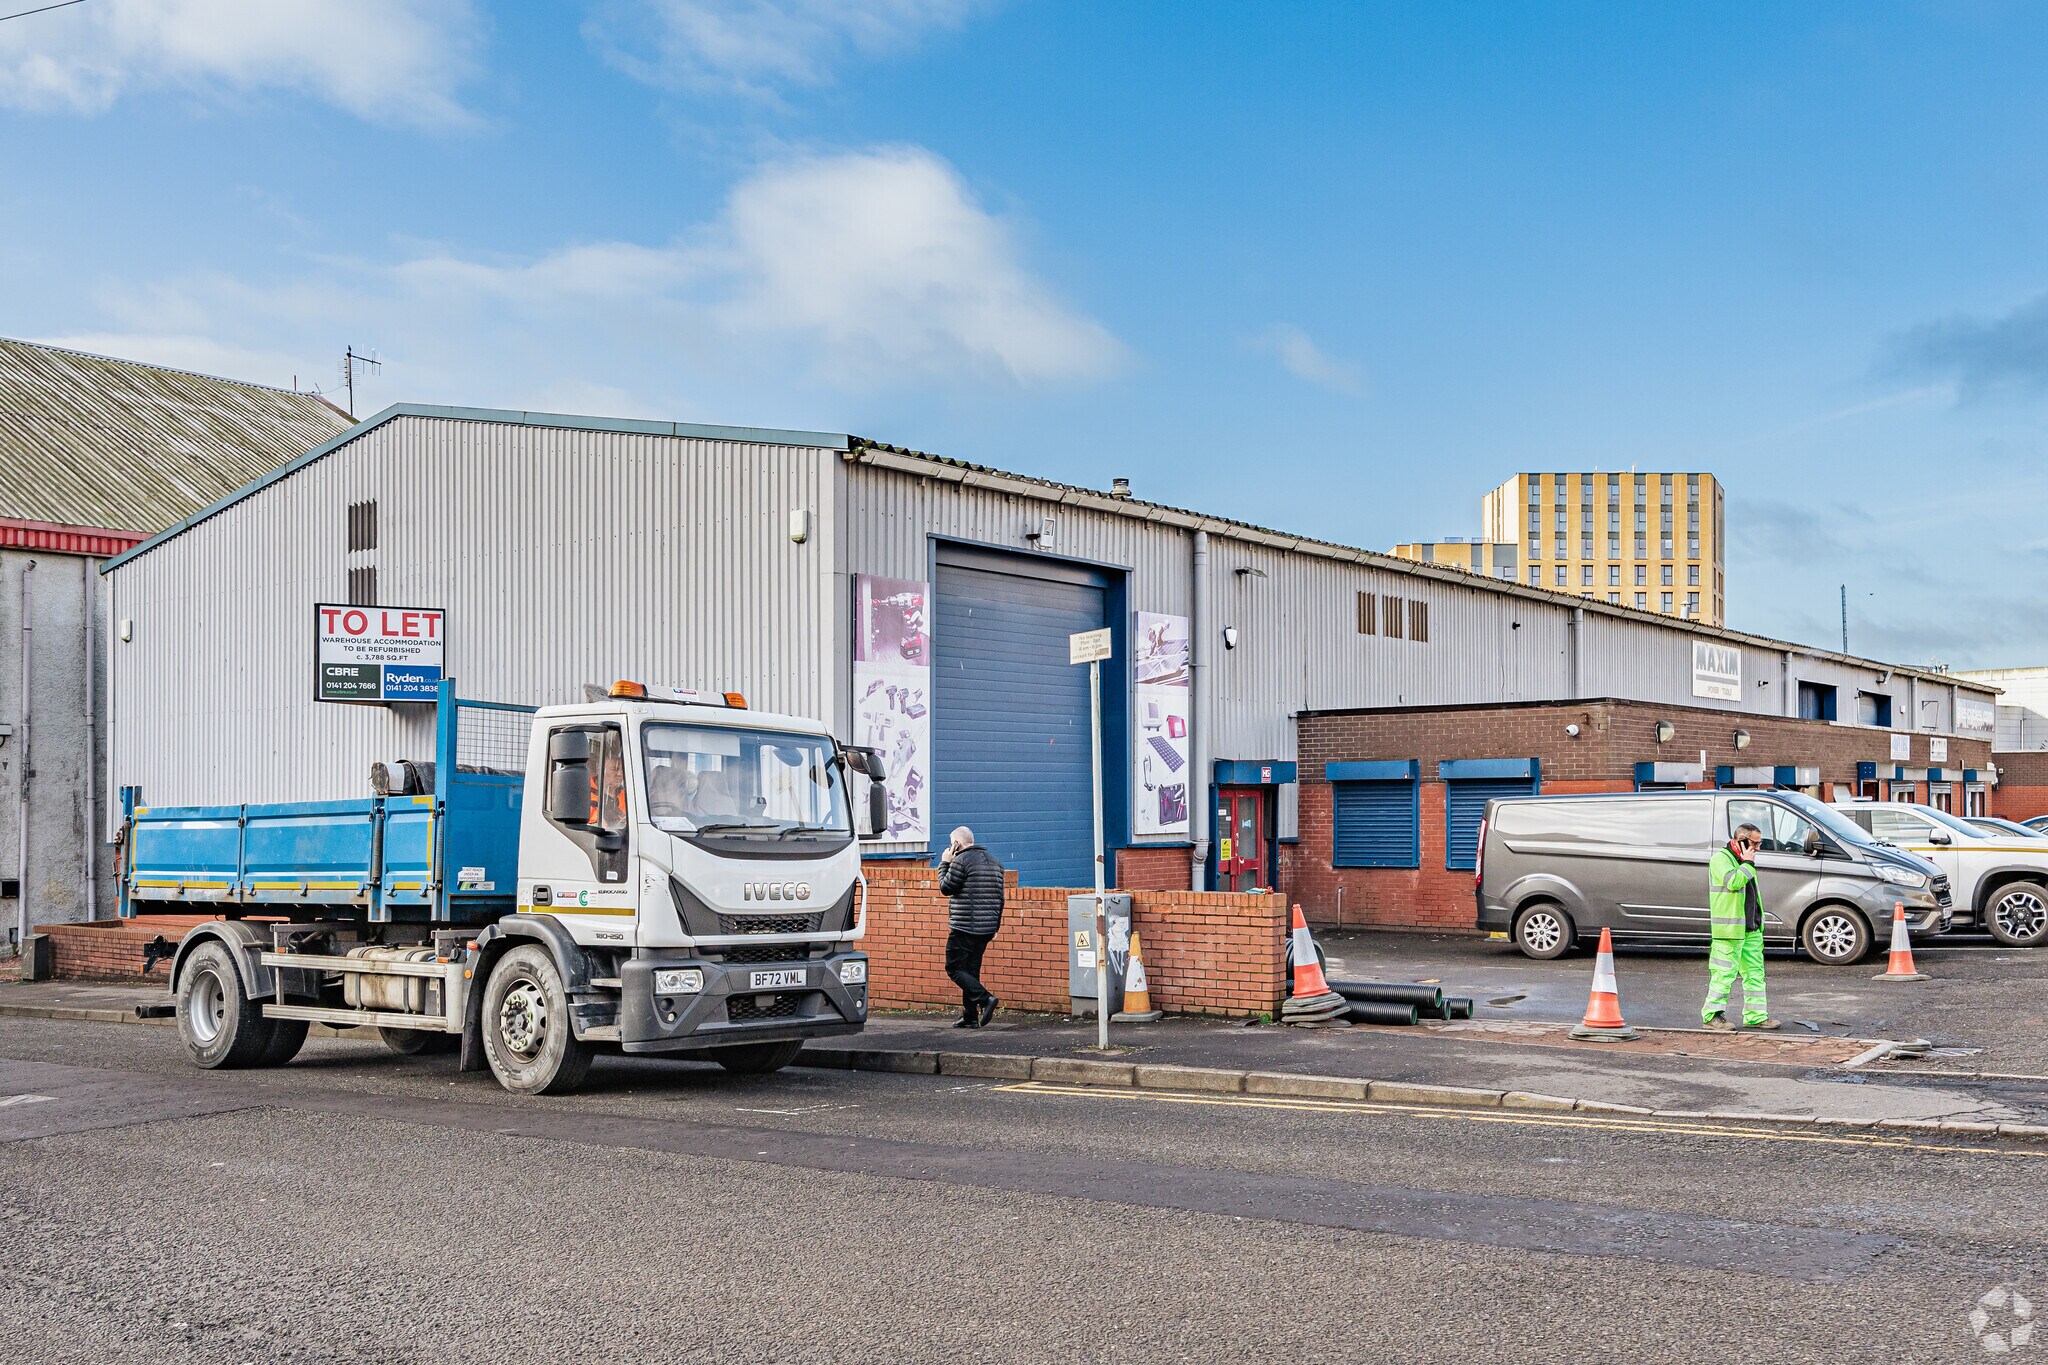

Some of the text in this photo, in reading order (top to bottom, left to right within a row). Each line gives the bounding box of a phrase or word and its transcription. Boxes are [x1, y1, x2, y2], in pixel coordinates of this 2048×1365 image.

[321, 609, 442, 638] TO LET
[321, 636, 442, 647] WAREHOUSE ACCOMMODATION
[368, 646, 421, 654] REFURBISHED
[1696, 646, 1738, 675] MAXIM
[326, 667, 359, 677] CBRE
[1708, 686, 1719, 694] POWER
[743, 881, 811, 901] IVECO
[595, 932, 624, 940] 180-250
[755, 971, 802, 986] BF72 VML
